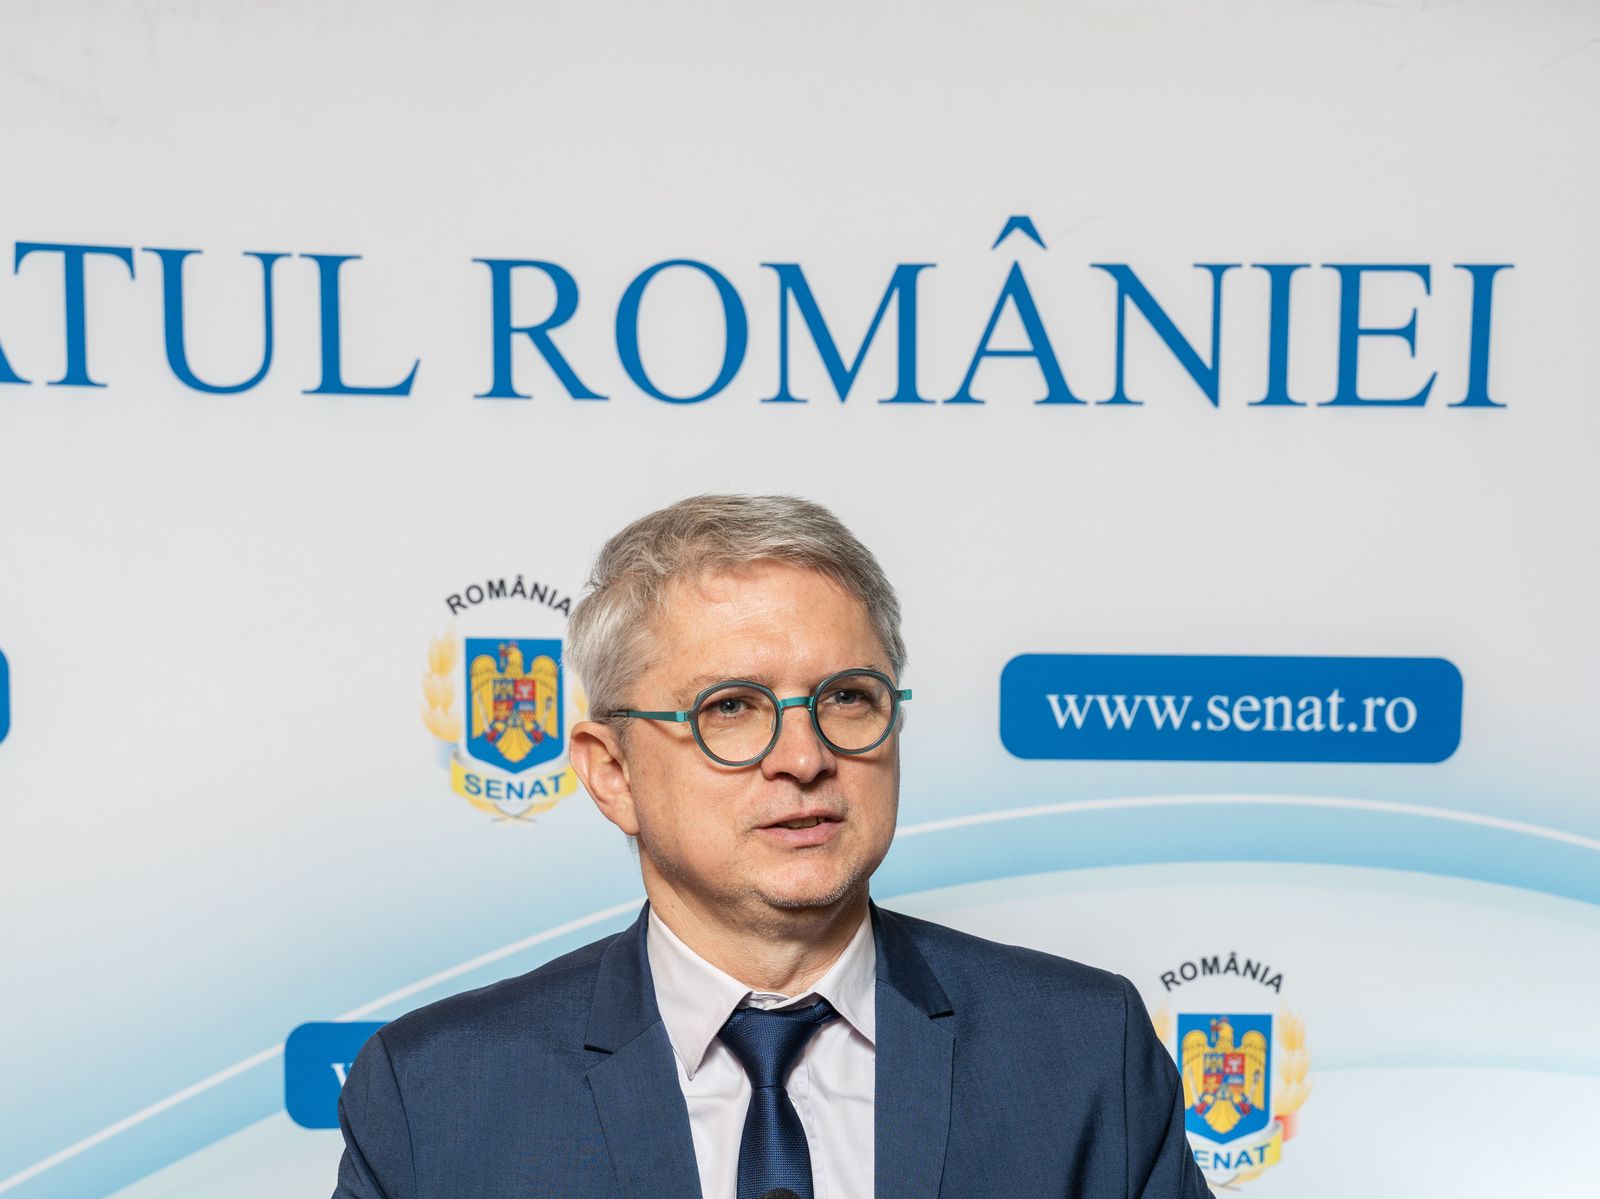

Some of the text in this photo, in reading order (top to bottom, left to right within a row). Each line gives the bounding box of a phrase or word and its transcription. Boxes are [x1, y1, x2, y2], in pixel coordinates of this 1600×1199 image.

[0, 214, 1515, 409] TUL ROMÂNIEI
[446, 574, 571, 617] ROMÂNIA
[1046, 688, 1418, 733] www.senat.ro
[463, 772, 566, 800] SENAT
[1160, 952, 1284, 993] ROMÂNIA
[1193, 1142, 1271, 1169] ENAT
